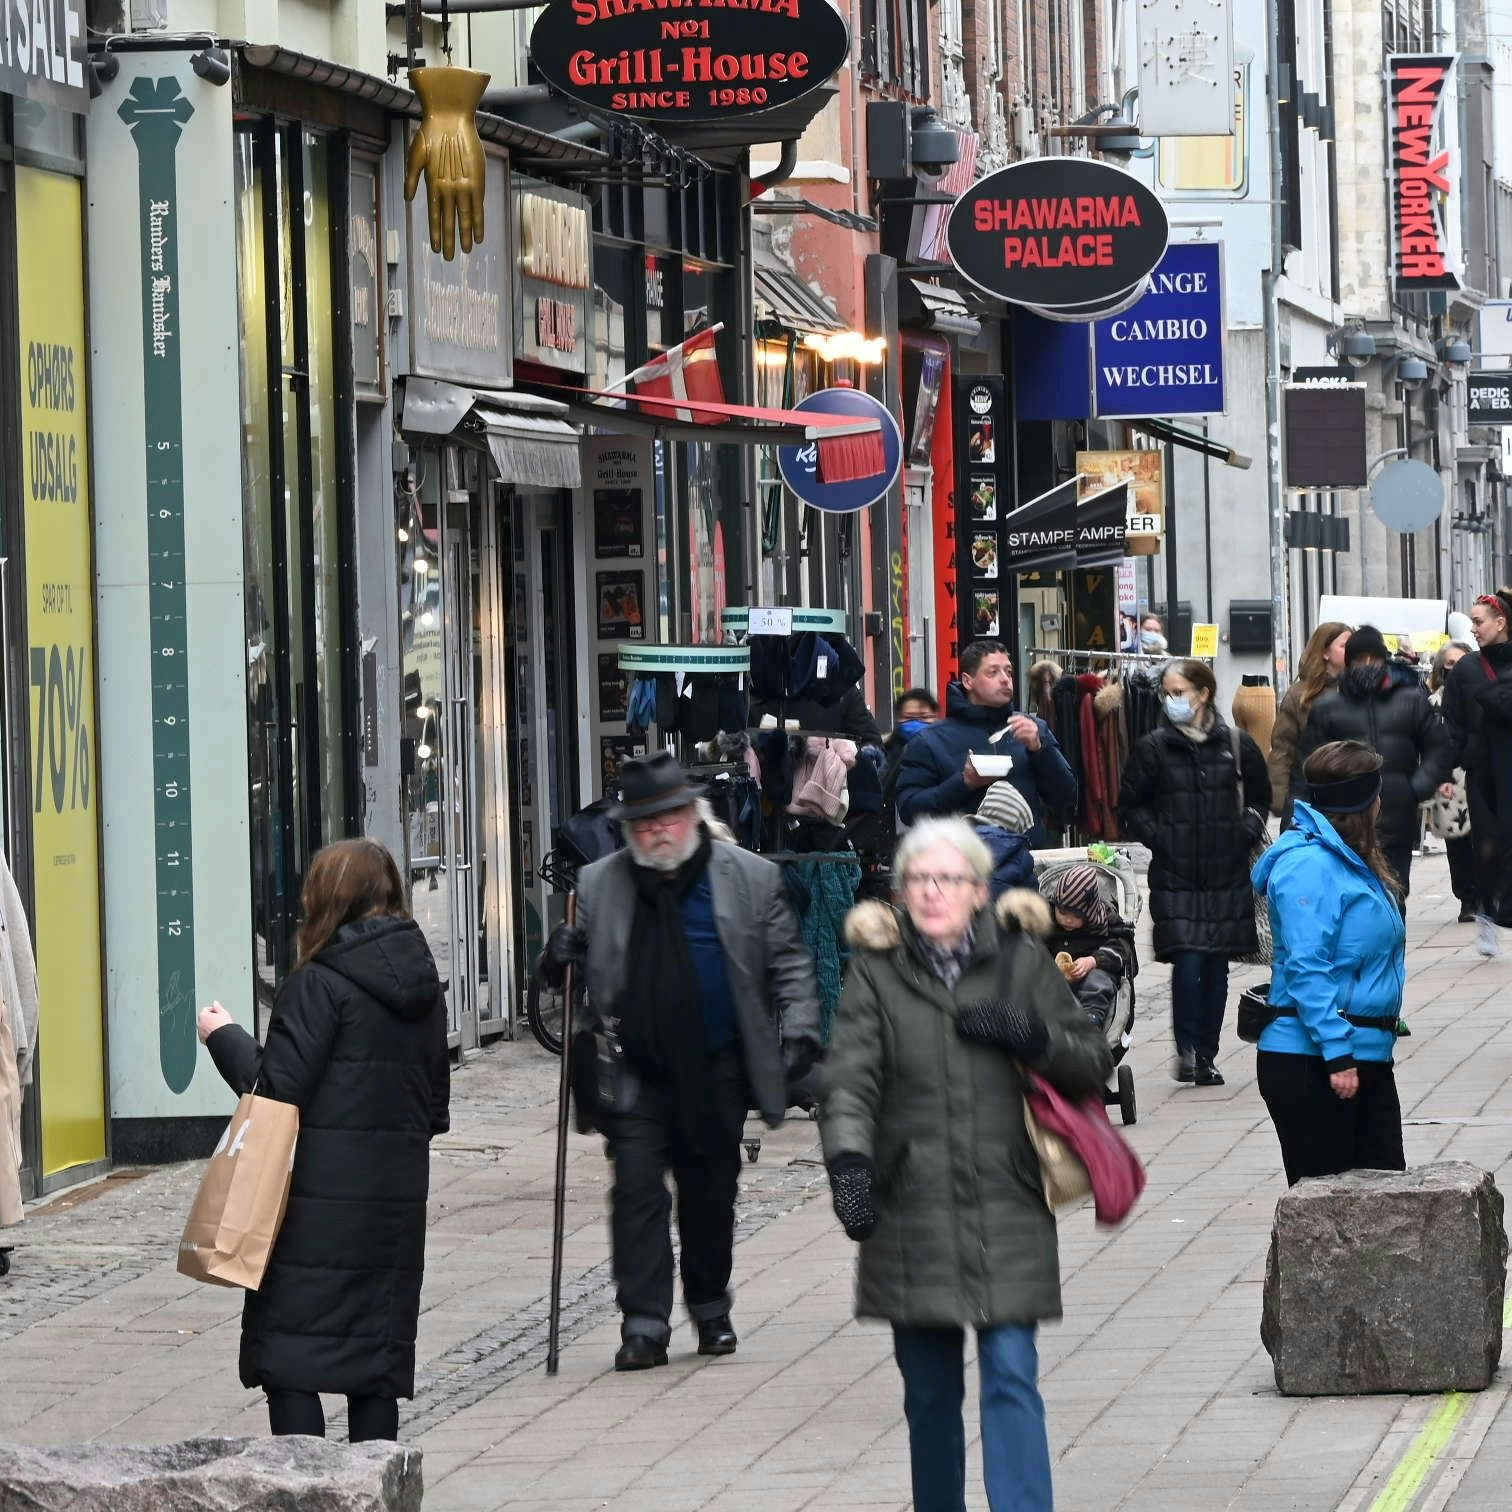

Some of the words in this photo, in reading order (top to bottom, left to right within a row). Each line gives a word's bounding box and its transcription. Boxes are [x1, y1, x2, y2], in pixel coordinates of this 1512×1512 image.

[572, 0, 800, 25] SHAMA
[568, 47, 809, 86] Grill-House
[611, 91, 690, 110] SINCE
[708, 87, 768, 107] 1980
[974, 196, 1142, 231] SHAWARMA
[1004, 234, 1114, 269] PALACE
[1110, 318, 1208, 342] CAMBIO
[28, 341, 75, 413] OPHØRS
[1102, 365, 1219, 389] WECHSEL
[1470, 387, 1510, 399] DEDIC
[157, 440, 170, 451] 5
[29, 431, 77, 504] UDSALG
[160, 508, 172, 519] 6
[1009, 530, 1074, 547] STAMPE
[1077, 527, 1125, 541] AMPE
[160, 580, 174, 590] 7
[42, 583, 56, 613] SPAR
[56, 584, 64, 613] OP
[64, 584, 73, 614] TIL
[161, 646, 175, 657] 8
[30, 643, 90, 815] 70%
[163, 715, 177, 726] 9
[165, 780, 179, 798] 10
[167, 850, 180, 867] 11
[168, 918, 182, 937] 12
